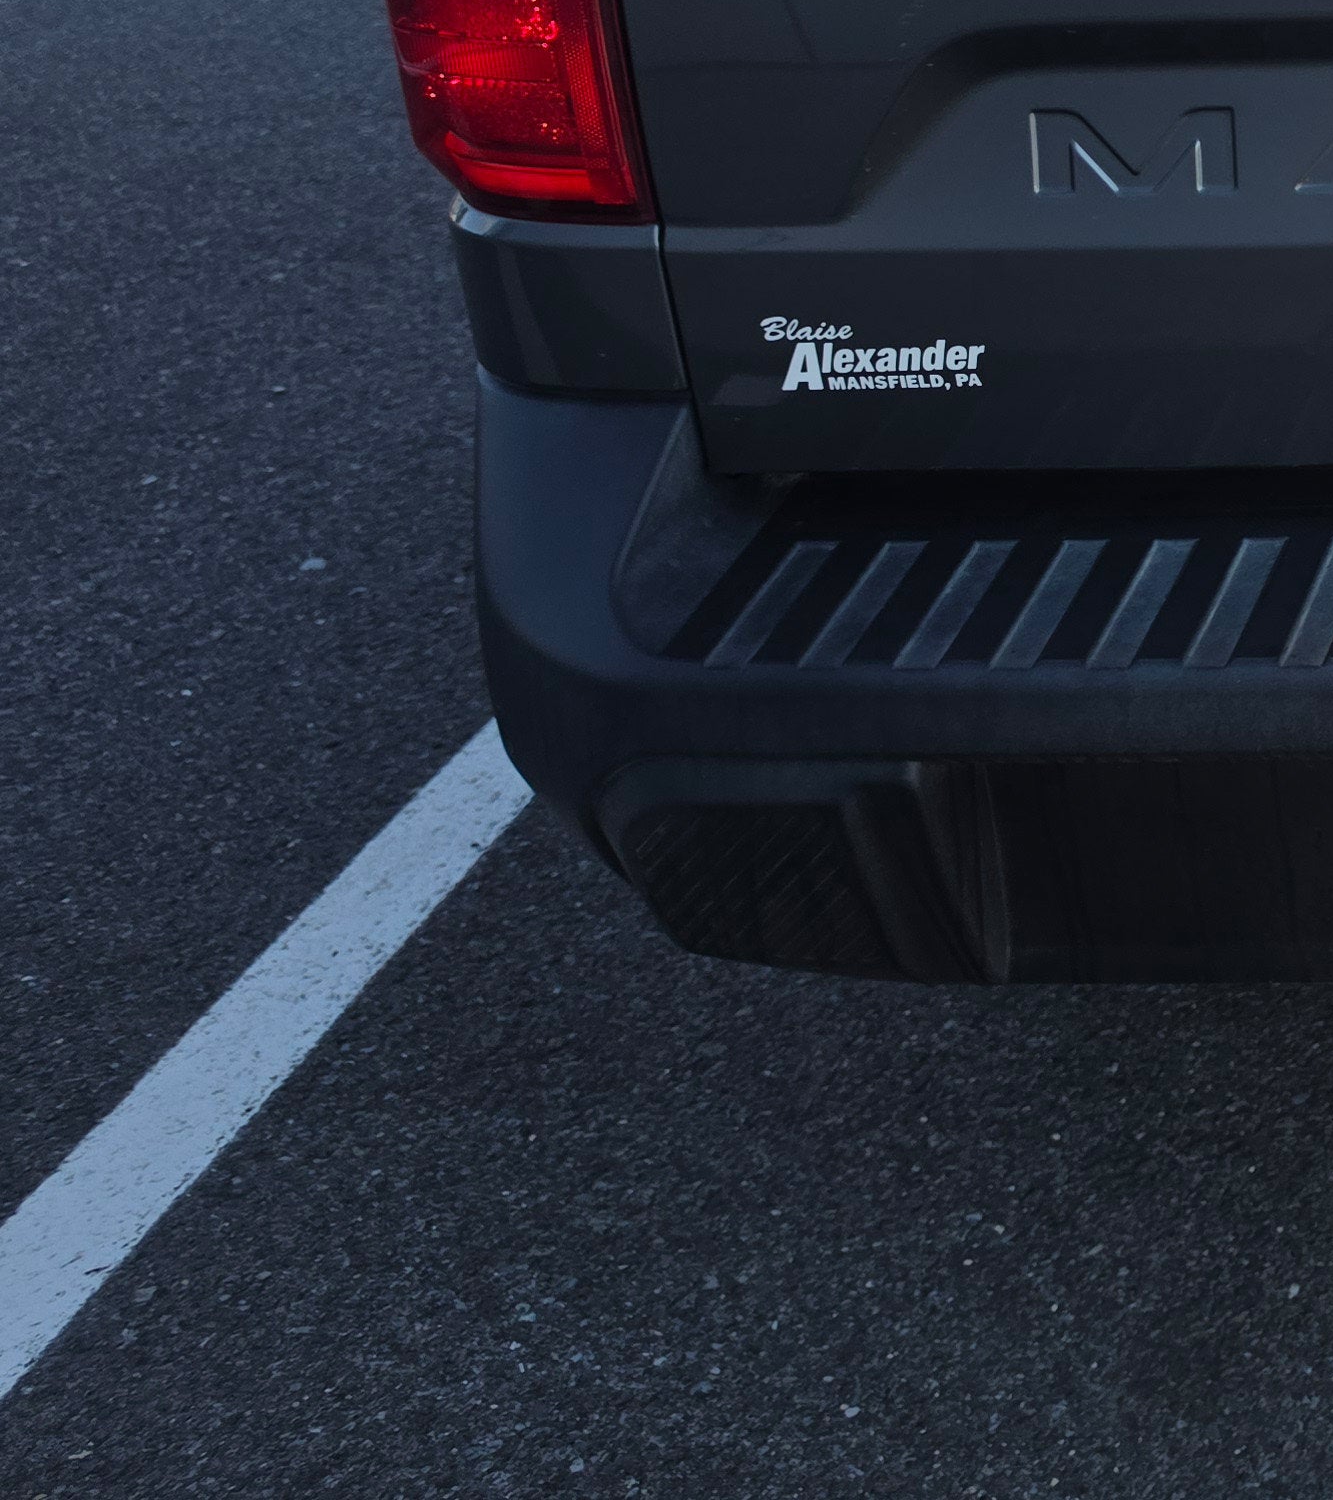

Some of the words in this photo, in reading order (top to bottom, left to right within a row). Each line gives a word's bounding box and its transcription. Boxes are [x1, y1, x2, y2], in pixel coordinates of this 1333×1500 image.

[759, 315, 855, 342] Blaise
[781, 339, 986, 391] Alexander
[827, 373, 951, 391] MANSFIELD,
[955, 373, 983, 388] PA
